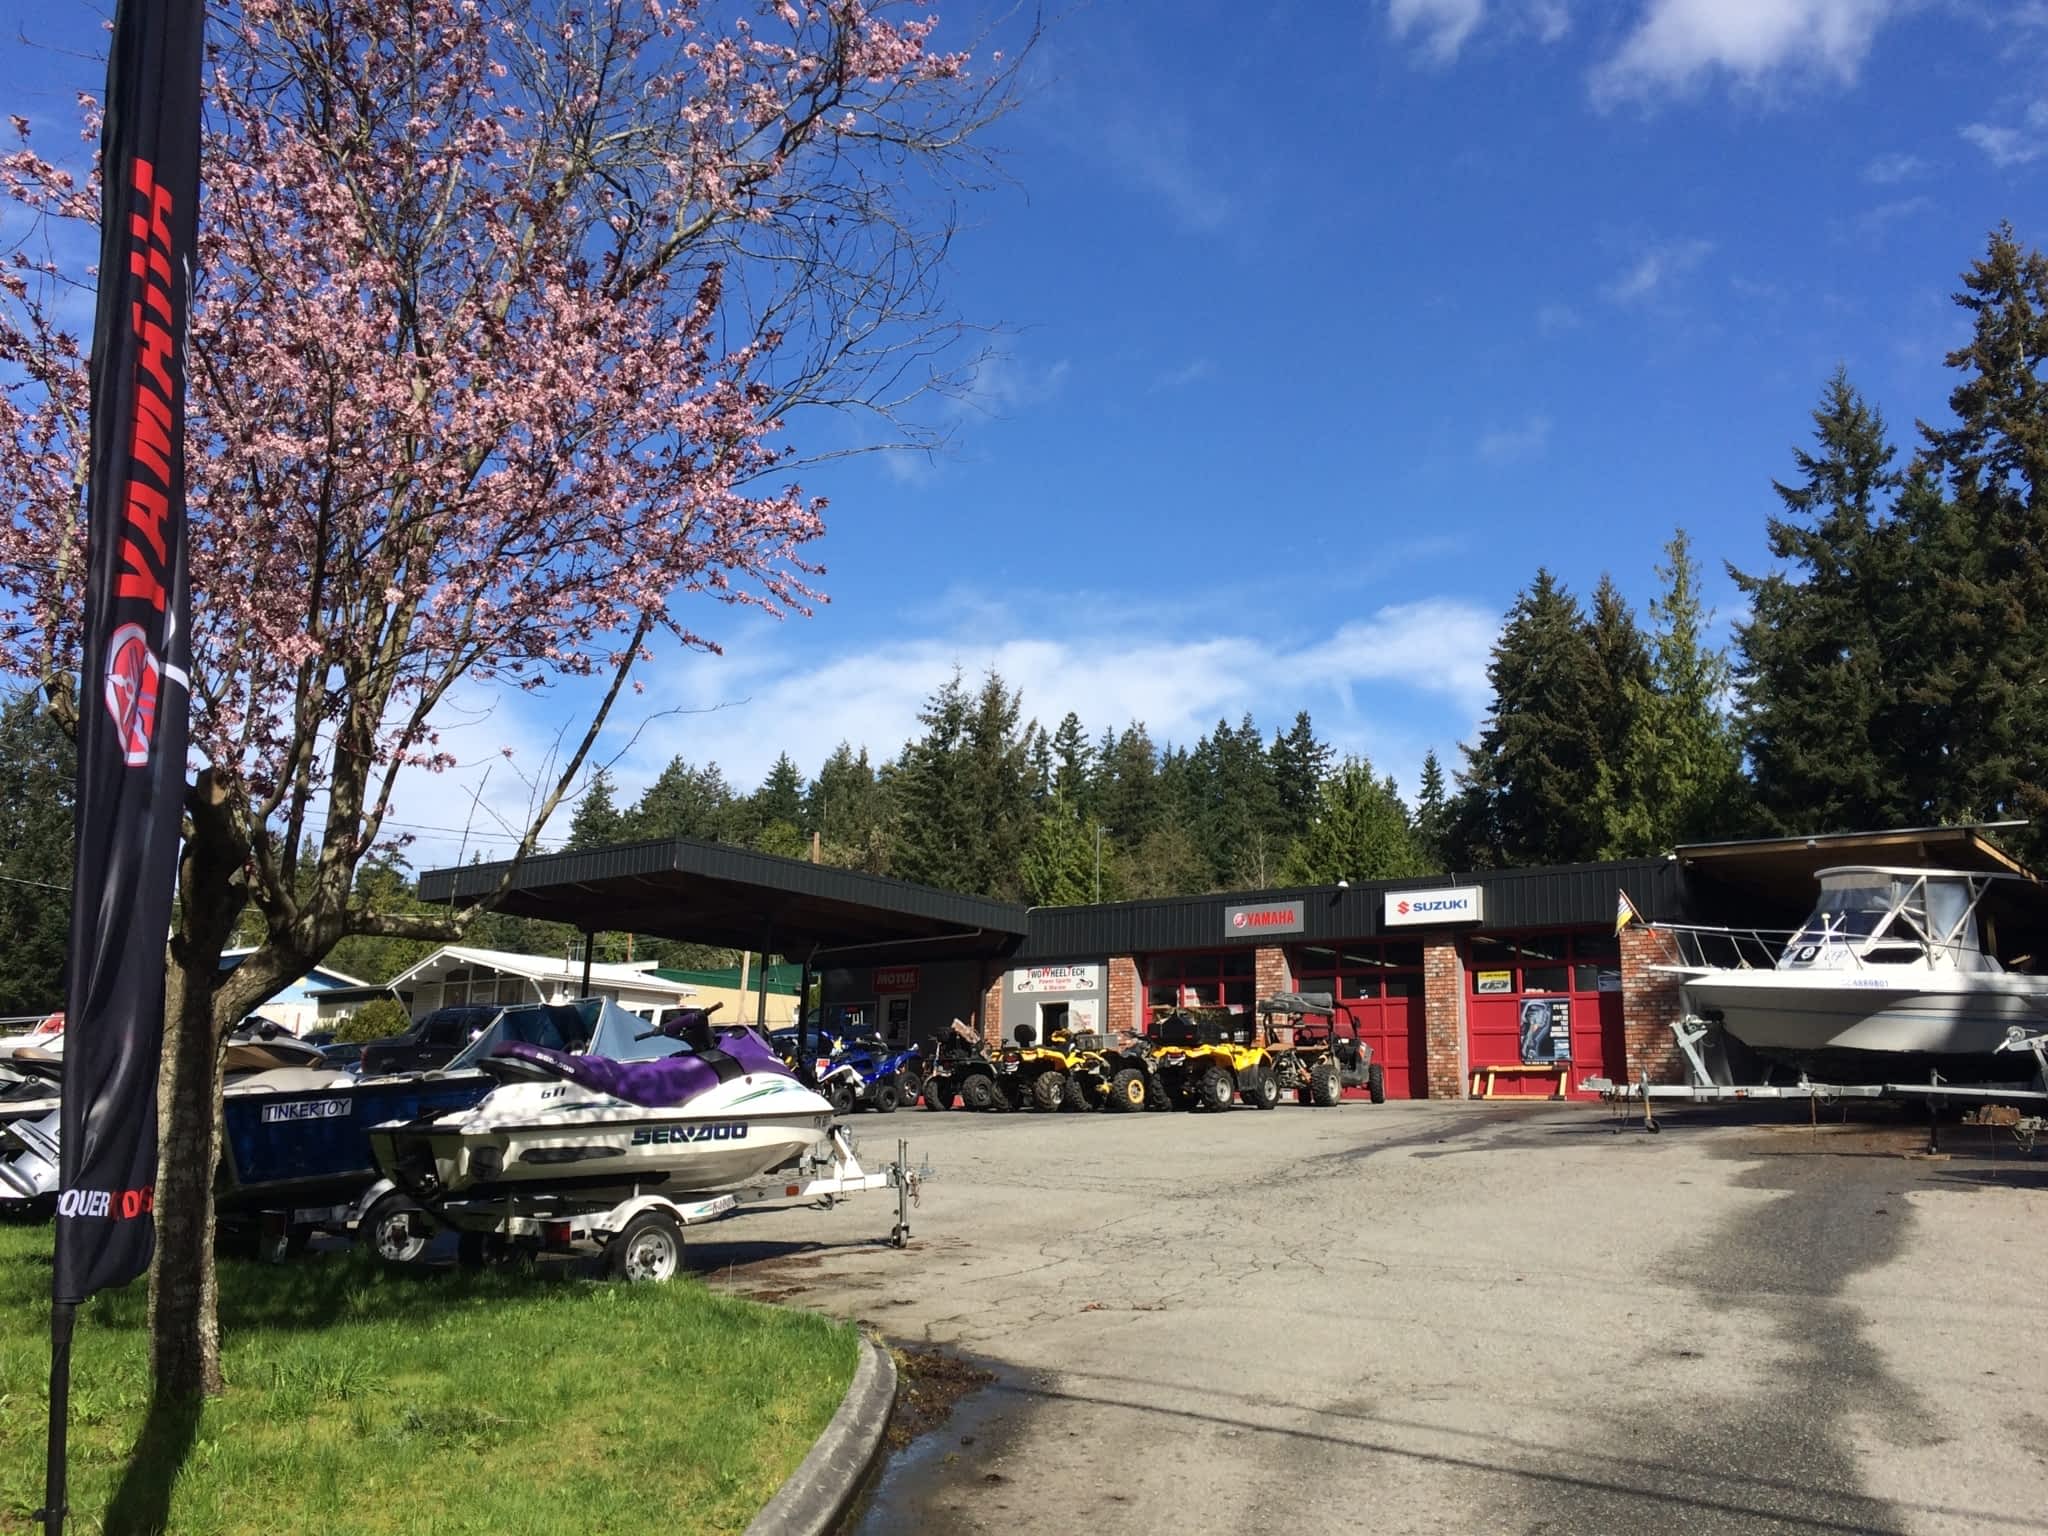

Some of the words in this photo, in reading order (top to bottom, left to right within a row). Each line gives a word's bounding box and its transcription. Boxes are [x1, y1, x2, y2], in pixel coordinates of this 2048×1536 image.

[1413, 899, 1468, 912] SUZUKI
[1247, 910, 1296, 927] YAMAHA
[264, 1100, 350, 1121] TINKERTOY
[57, 1189, 111, 1218] QUER
